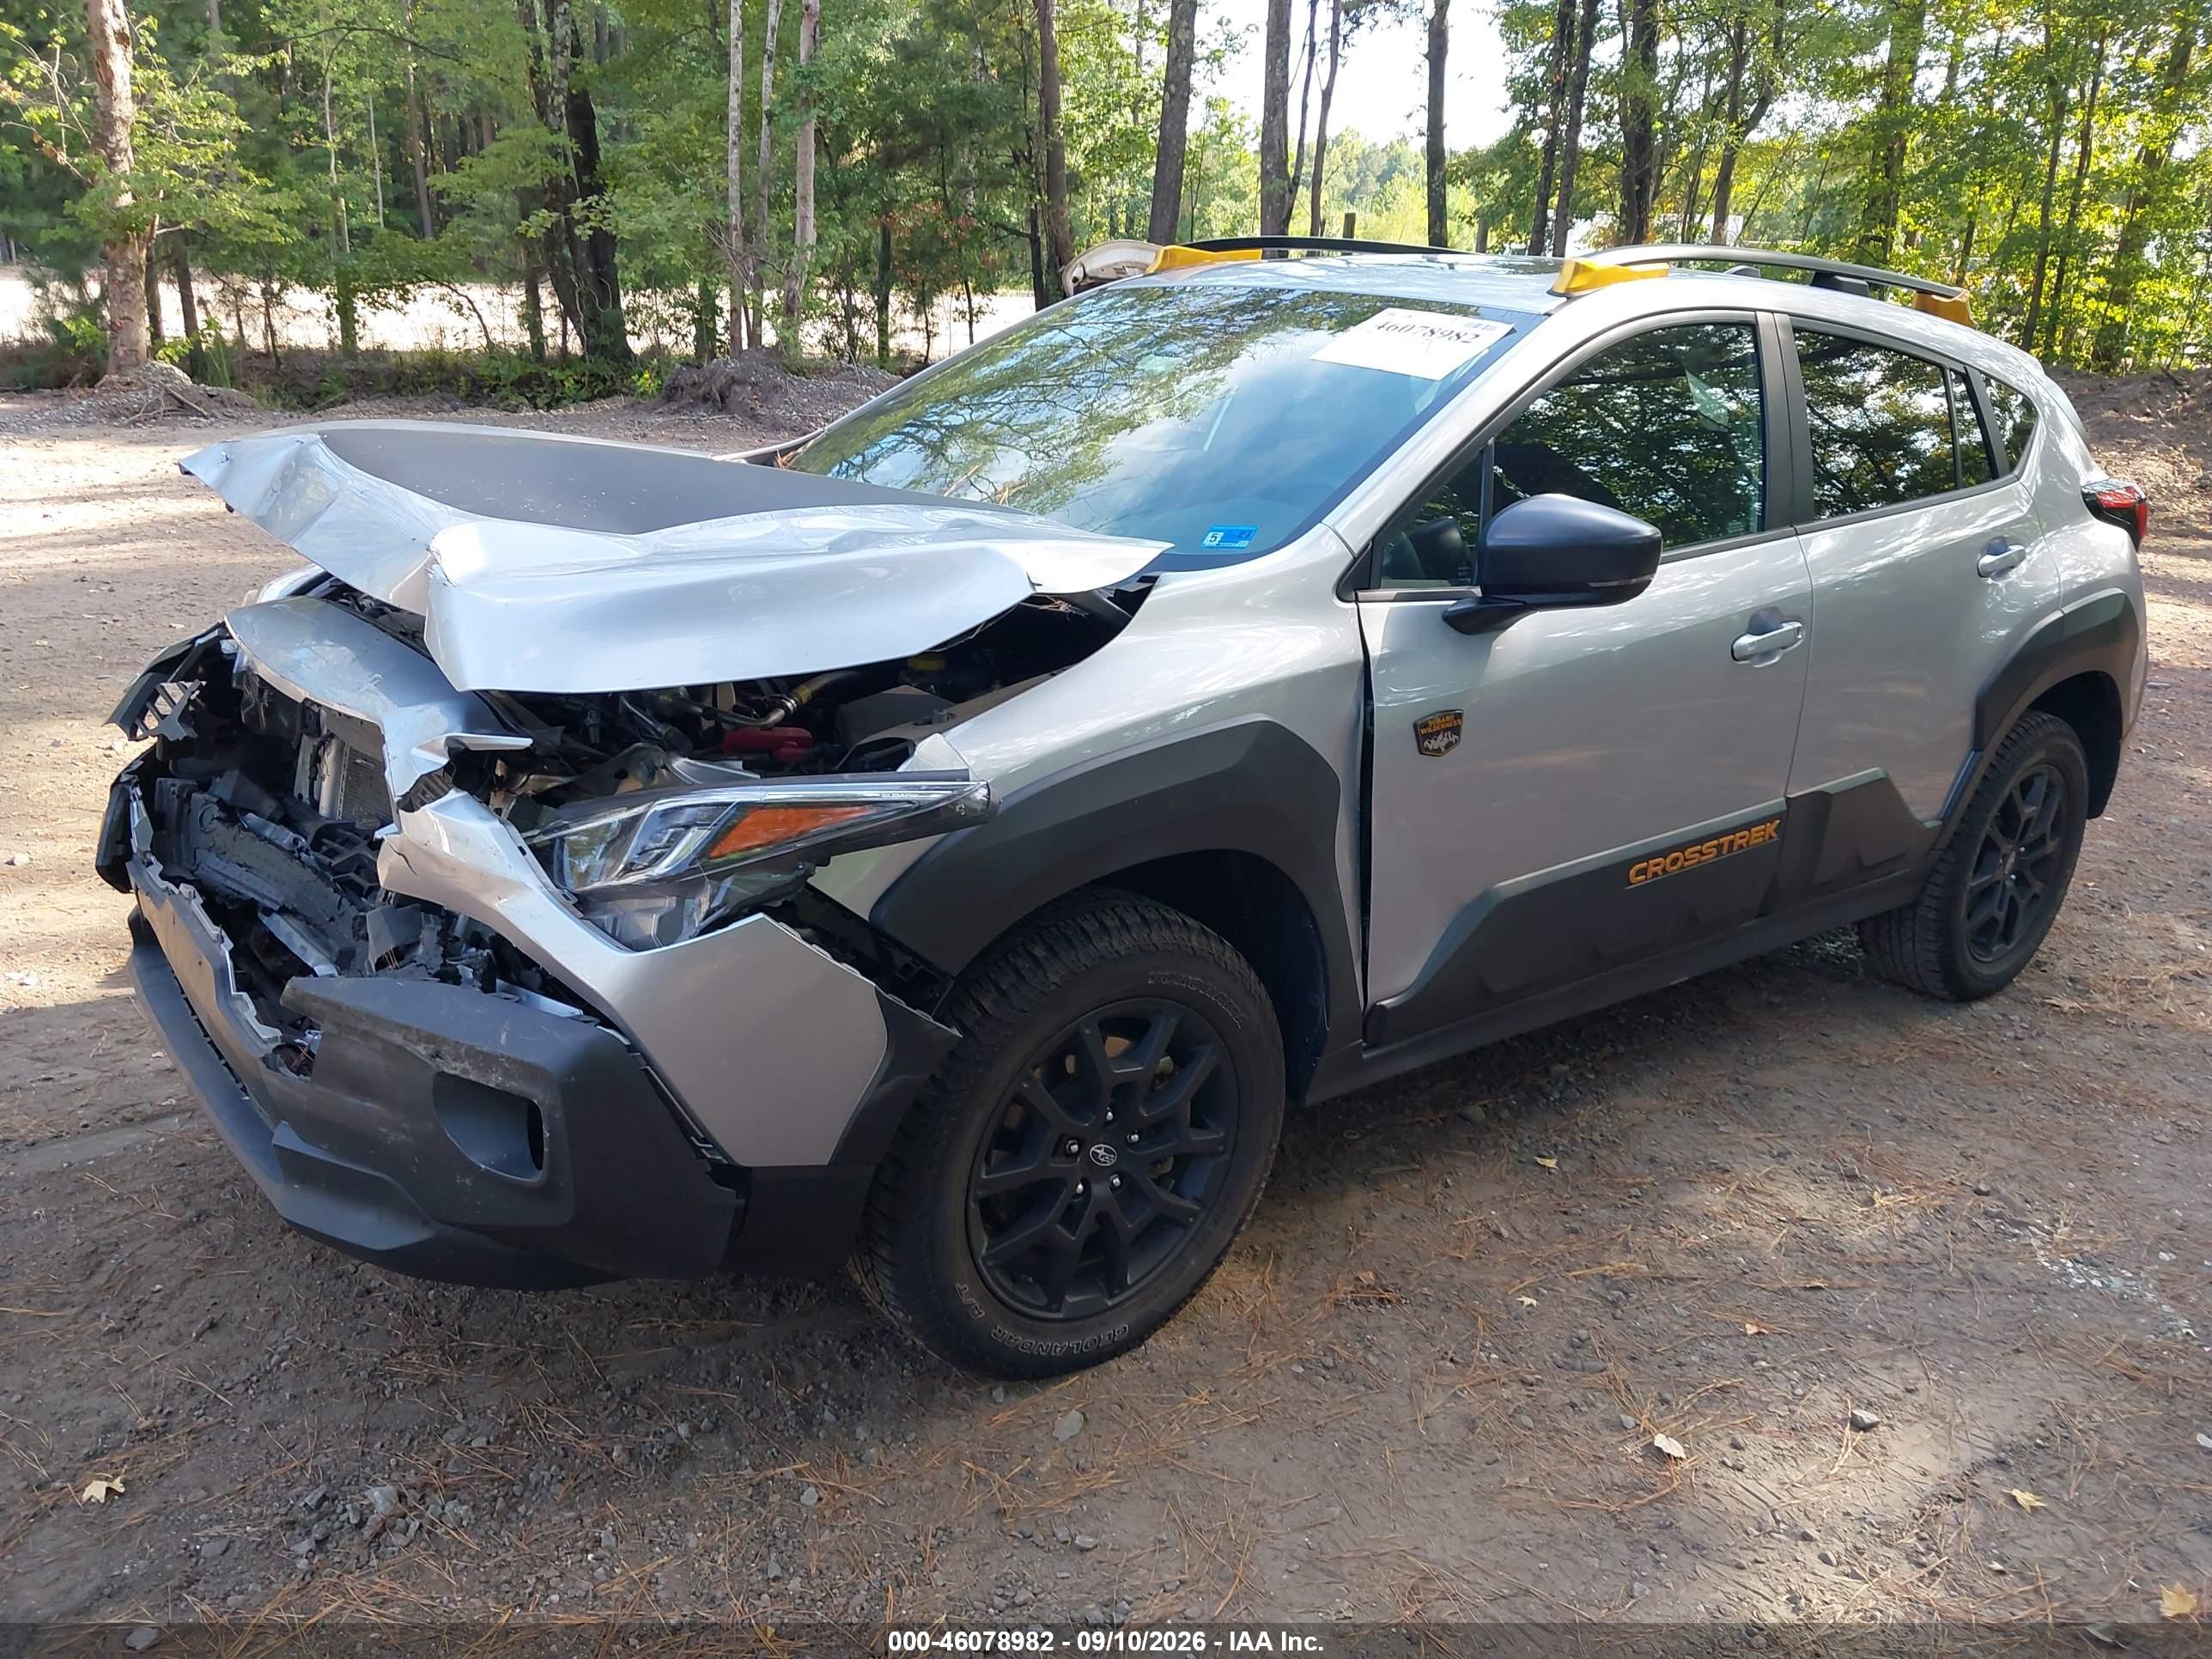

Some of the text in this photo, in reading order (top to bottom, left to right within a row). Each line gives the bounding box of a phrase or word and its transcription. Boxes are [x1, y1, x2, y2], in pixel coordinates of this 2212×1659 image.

[1374, 320, 1480, 343] 46078982
[1209, 532, 1219, 543] 5
[1628, 819, 1781, 884] CROSSTREK
[990, 1324, 1129, 1357] GEOLANDAR
